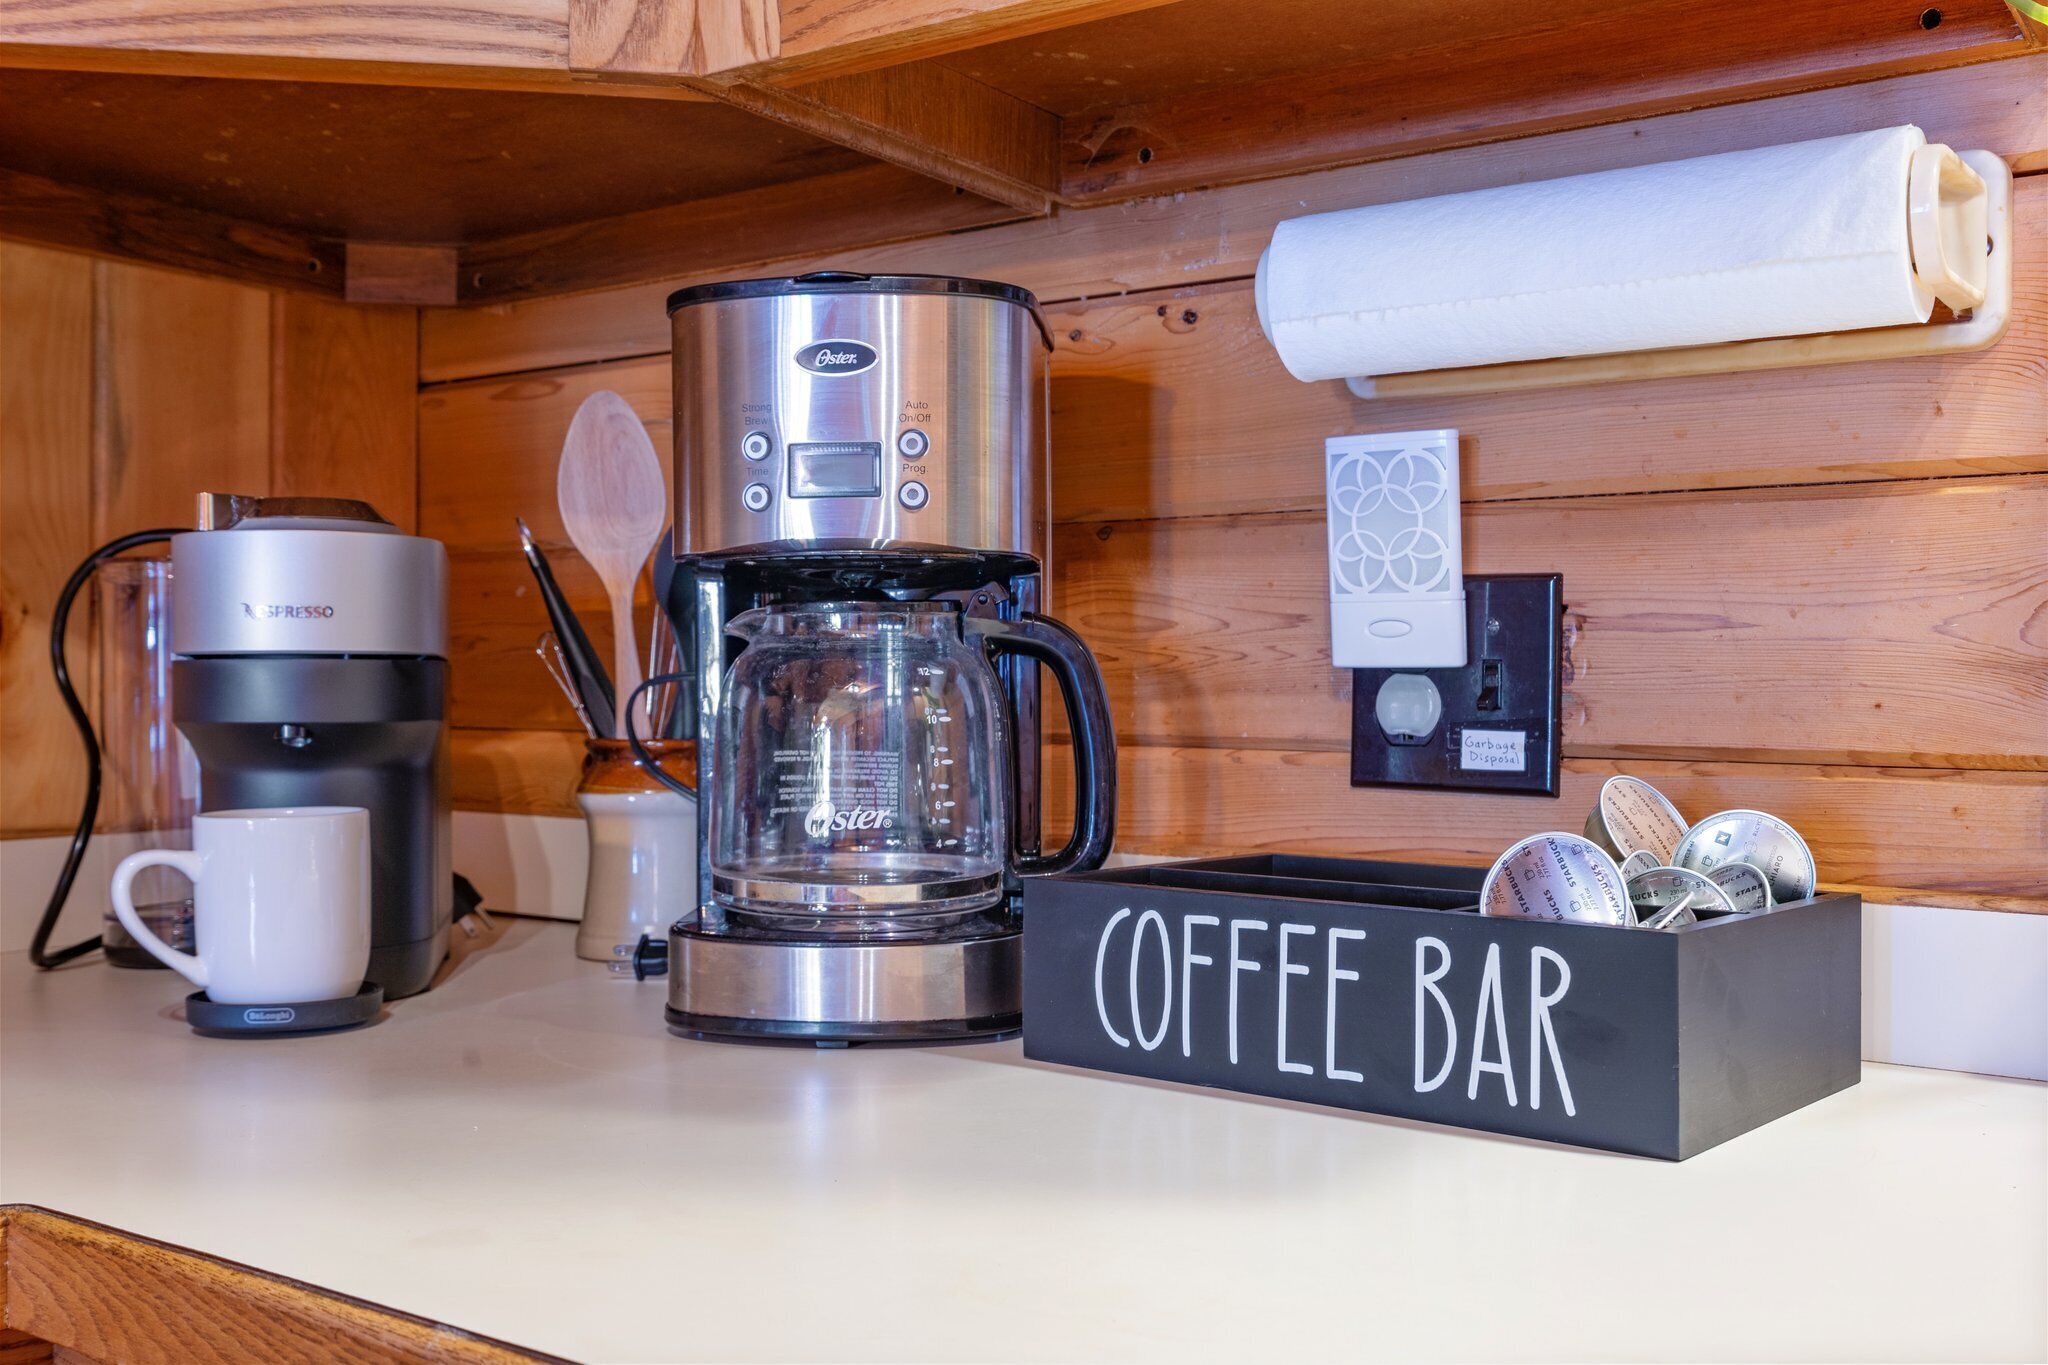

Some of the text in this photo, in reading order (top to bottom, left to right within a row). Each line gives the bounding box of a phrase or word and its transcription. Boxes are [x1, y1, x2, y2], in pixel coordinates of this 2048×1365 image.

[742, 404, 772, 414] Strong
[906, 401, 928, 410] Auto
[744, 416, 768, 426] Brew
[899, 413, 931, 422] On/Off
[744, 468, 768, 476] Time
[241, 602, 334, 619] NSPRESSO
[918, 668, 930, 676] 12
[926, 714, 938, 724] 10
[1464, 736, 1516, 754] Garbage
[934, 758, 939, 767] 8
[1470, 750, 1520, 767] Disposal
[935, 800, 941, 810] 6
[1095, 907, 1576, 1117] COFFEE BAR
